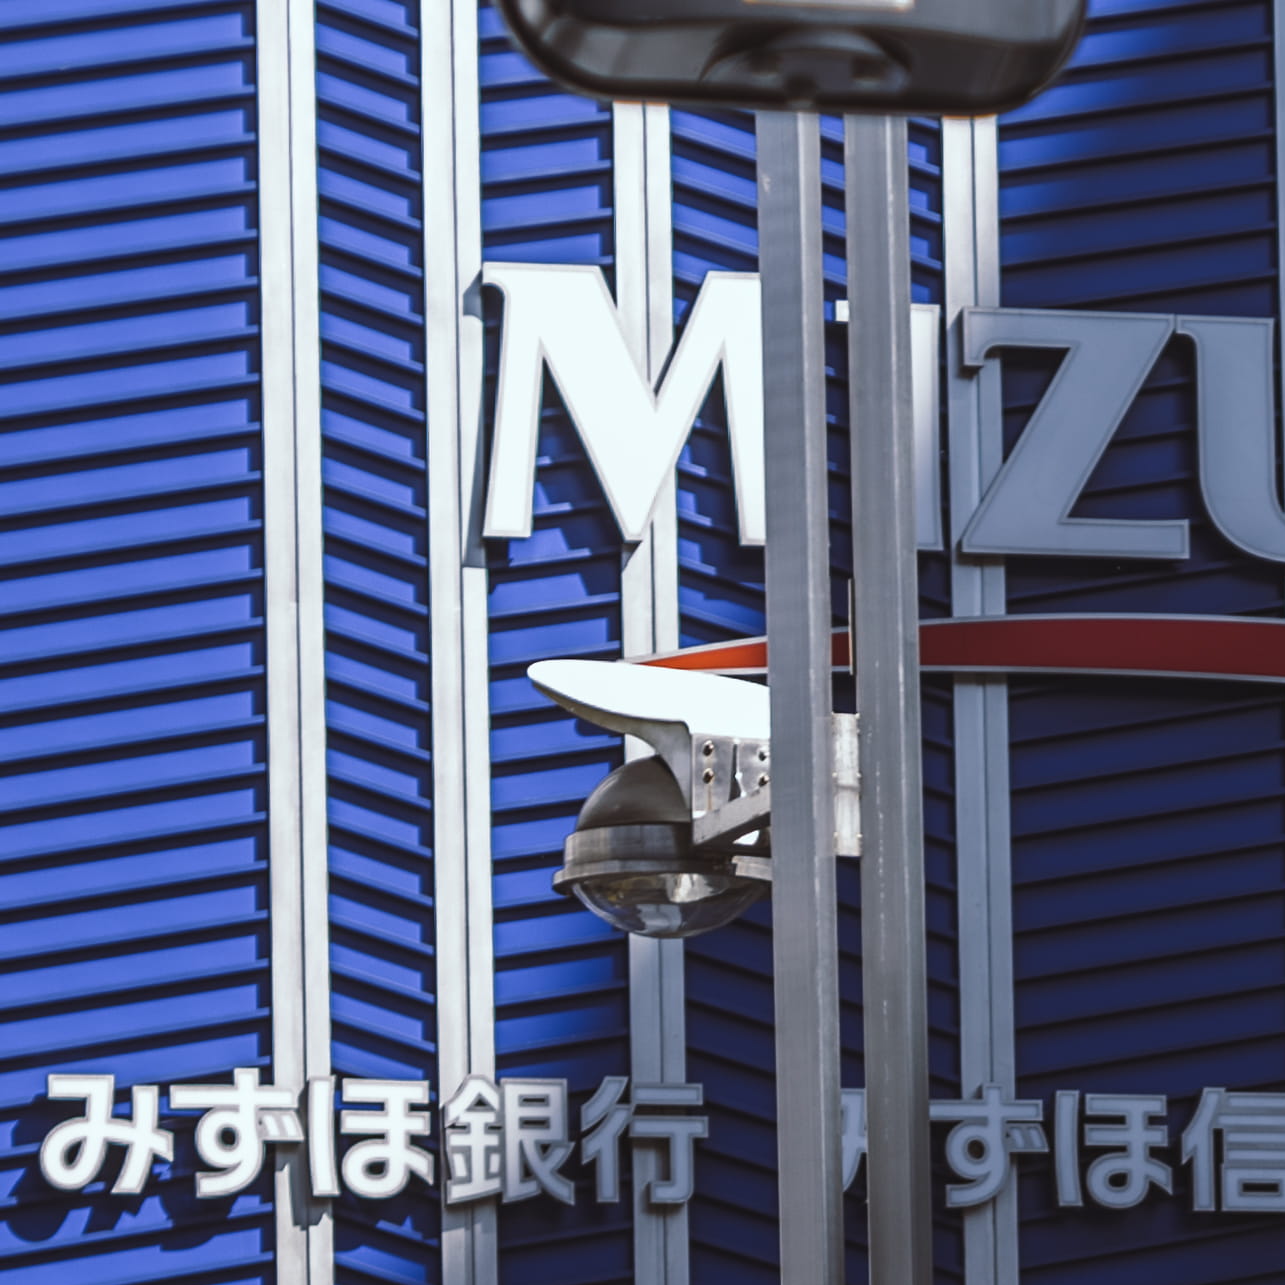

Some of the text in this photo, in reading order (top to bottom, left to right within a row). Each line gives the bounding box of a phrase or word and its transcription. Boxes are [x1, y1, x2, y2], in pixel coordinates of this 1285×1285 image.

[41, 1067, 709, 1205] みずほ銀行
